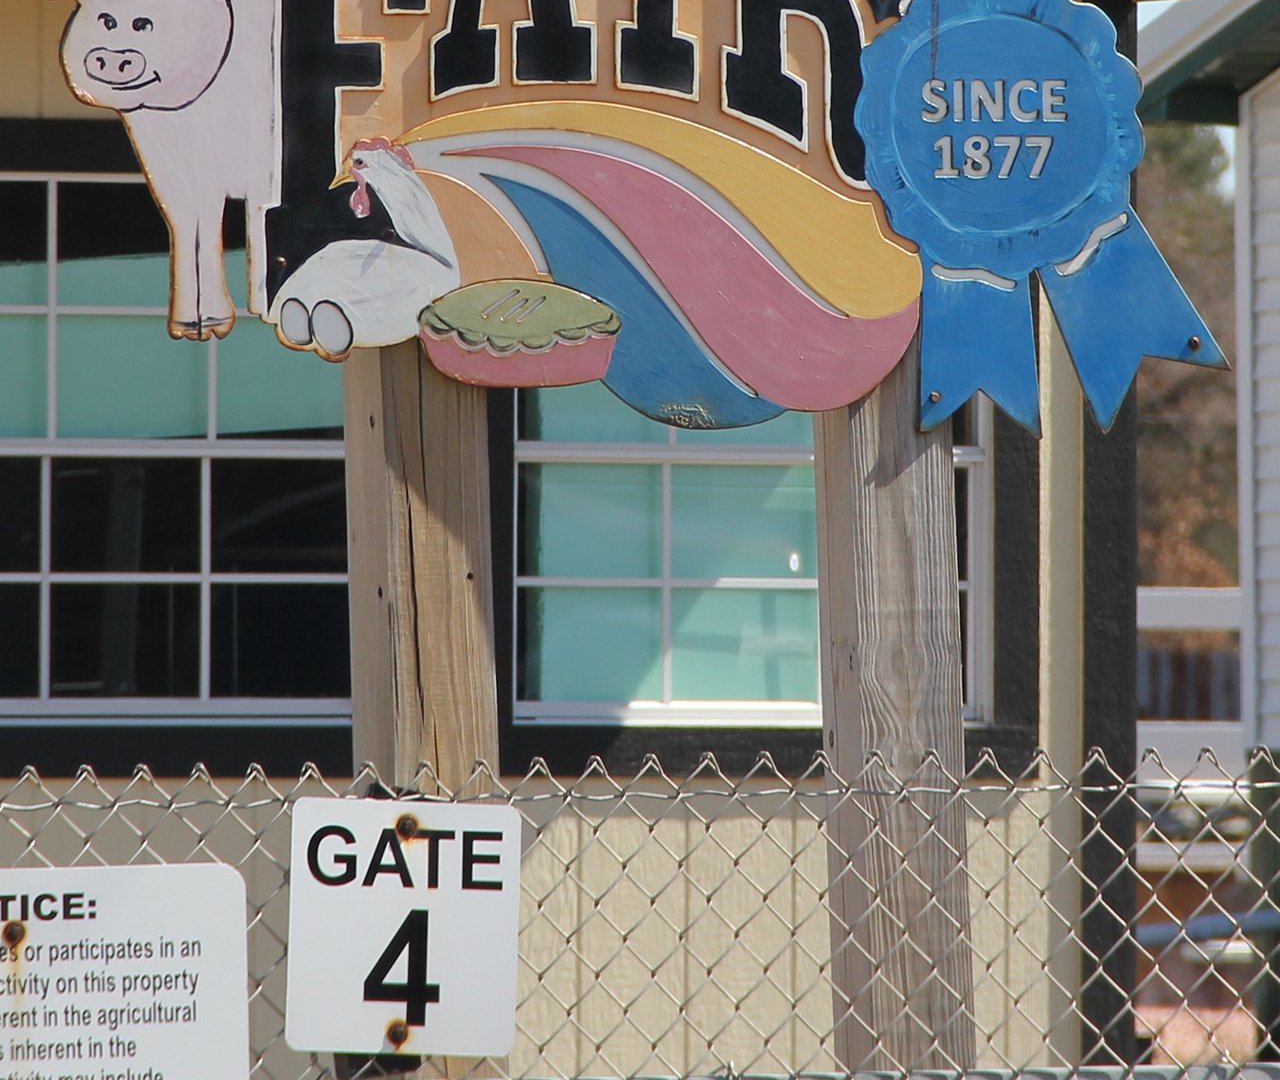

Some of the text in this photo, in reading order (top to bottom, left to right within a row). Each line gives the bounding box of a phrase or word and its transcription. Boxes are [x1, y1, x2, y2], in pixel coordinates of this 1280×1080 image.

[921, 78, 1068, 124] SINCE
[932, 134, 1053, 179] 1877
[307, 825, 503, 891] GATE
[24, 944, 44, 963] or
[48, 937, 154, 967] participates
[159, 935, 175, 959] in
[180, 939, 202, 958] an
[363, 909, 440, 1026] 4
[55, 976, 78, 995] on
[83, 970, 116, 994] this
[121, 968, 199, 998] property
[43, 1005, 58, 1027] in
[63, 1005, 92, 1027] the
[97, 1000, 197, 1032] agricultural
[10, 1037, 83, 1061] inherent
[88, 1036, 103, 1059] in
[108, 1035, 137, 1059] the
